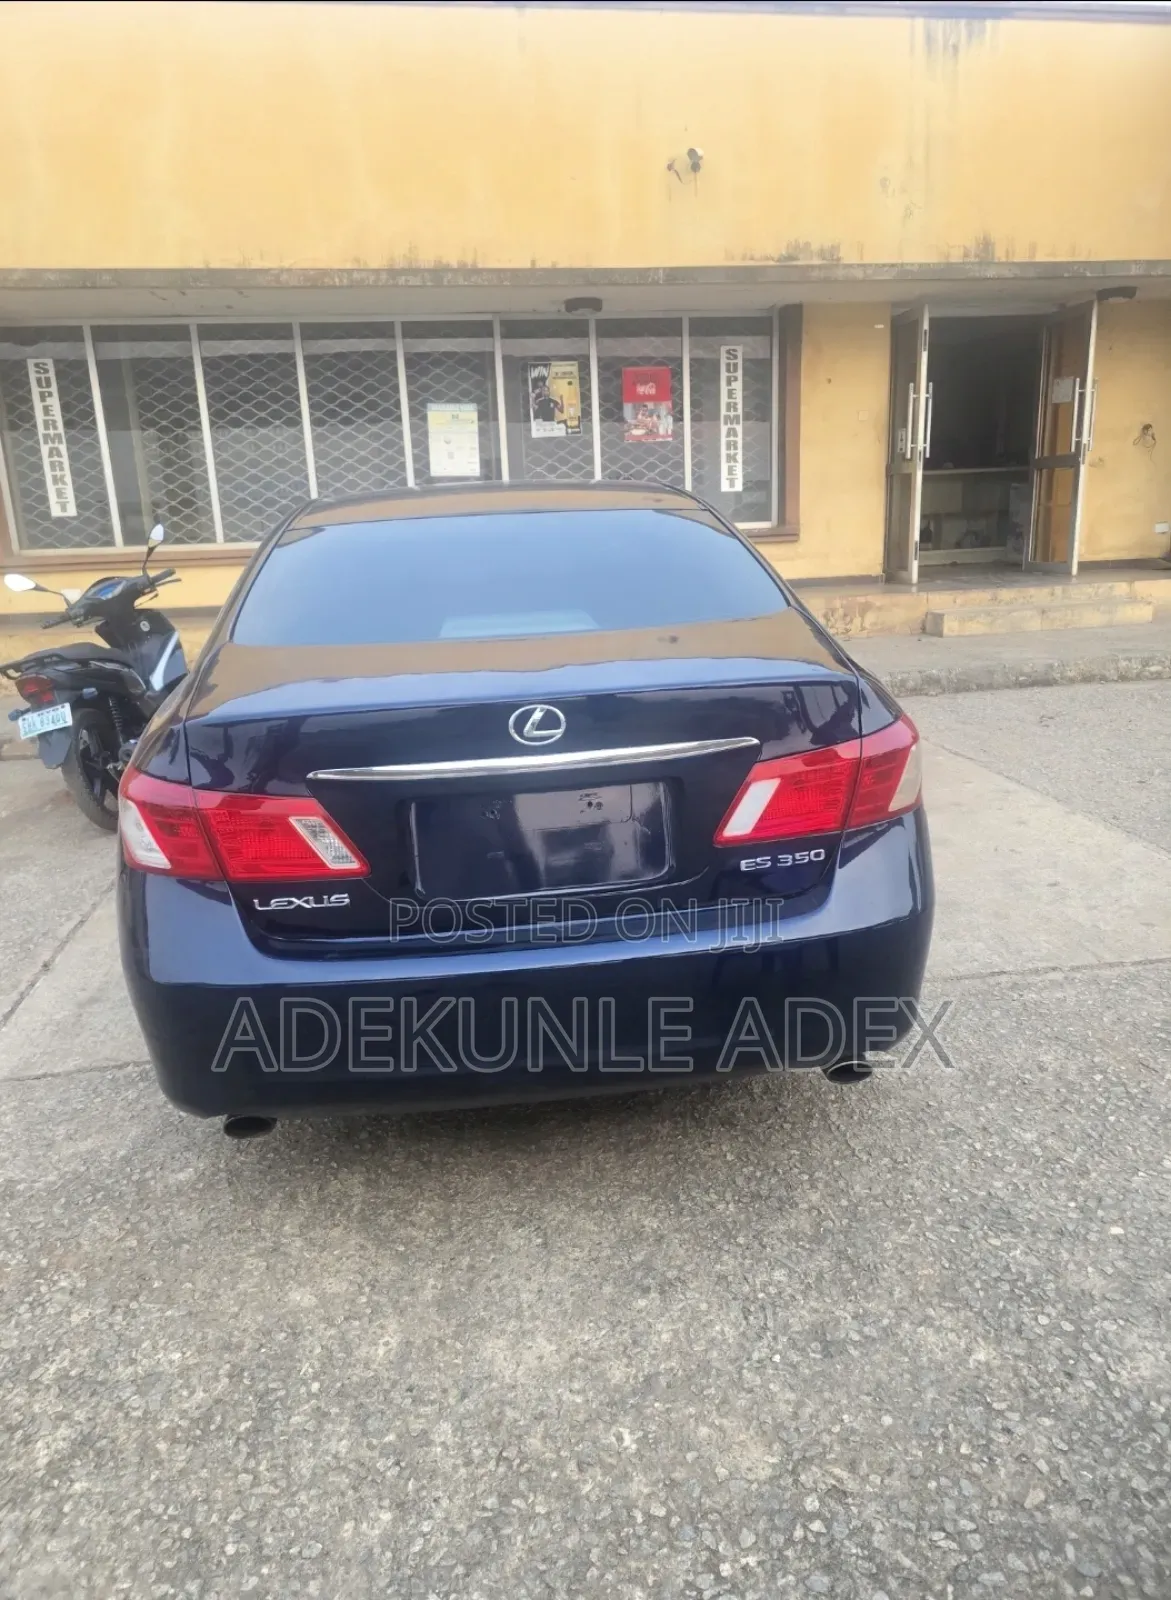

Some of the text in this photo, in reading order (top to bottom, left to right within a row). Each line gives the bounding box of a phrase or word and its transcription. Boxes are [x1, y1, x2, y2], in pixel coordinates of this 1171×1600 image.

[33, 362, 70, 513] SUPERMARKET
[723, 348, 741, 489] SUPERMARKET
[740, 848, 825, 871] ES 350
[253, 893, 351, 910] LEXUS
